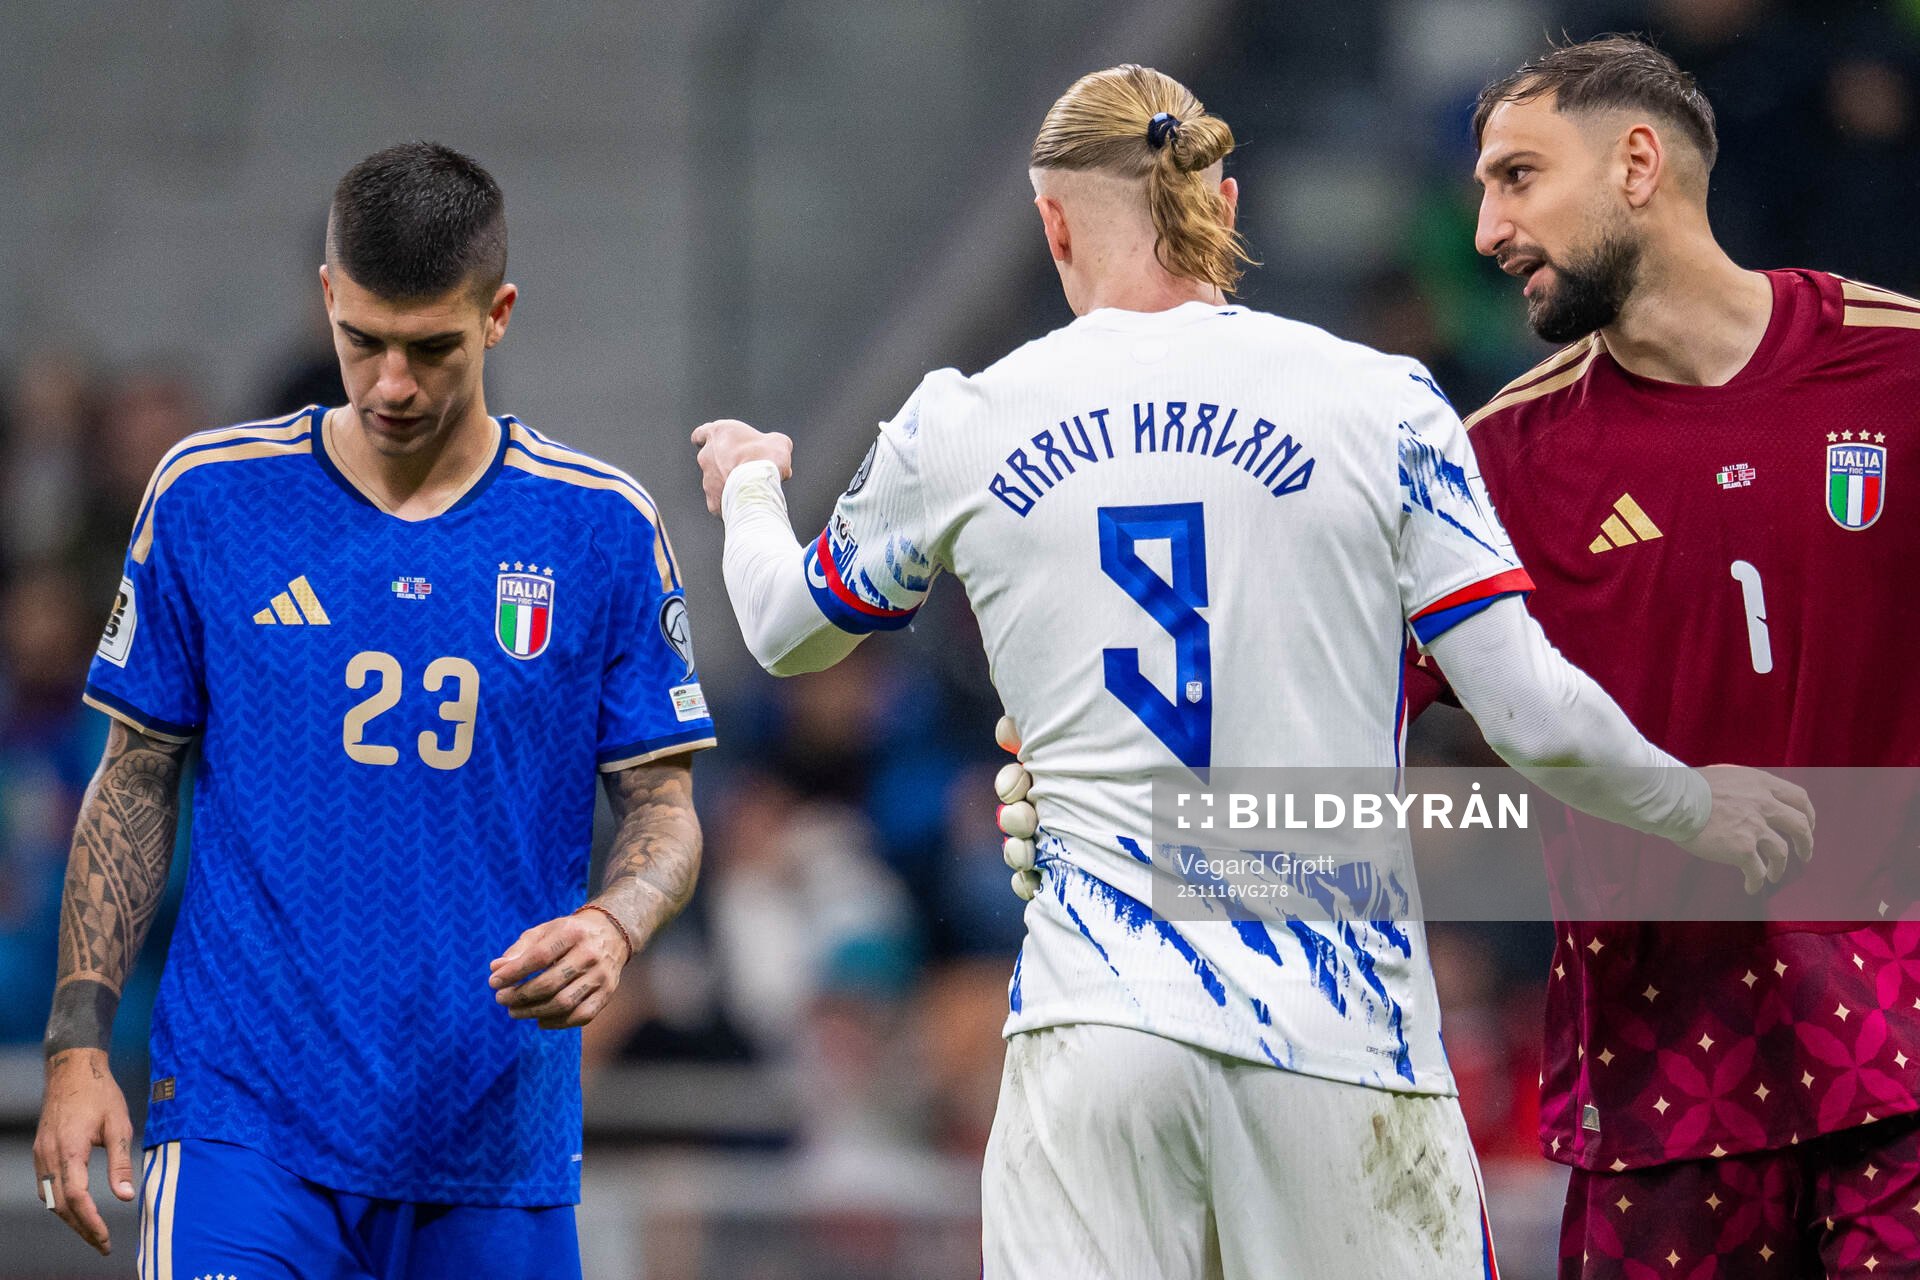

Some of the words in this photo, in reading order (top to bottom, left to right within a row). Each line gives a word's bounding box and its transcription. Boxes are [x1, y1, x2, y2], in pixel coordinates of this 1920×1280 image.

[988, 408, 1115, 517] BRAUT
[1133, 401, 1316, 498] HAALAND
[1831, 450, 1881, 468] ITALIA
[501, 579, 548, 599] ITALIA
[1097, 501, 1214, 786] 9
[1730, 560, 1773, 674] 1
[343, 650, 480, 770] 23
